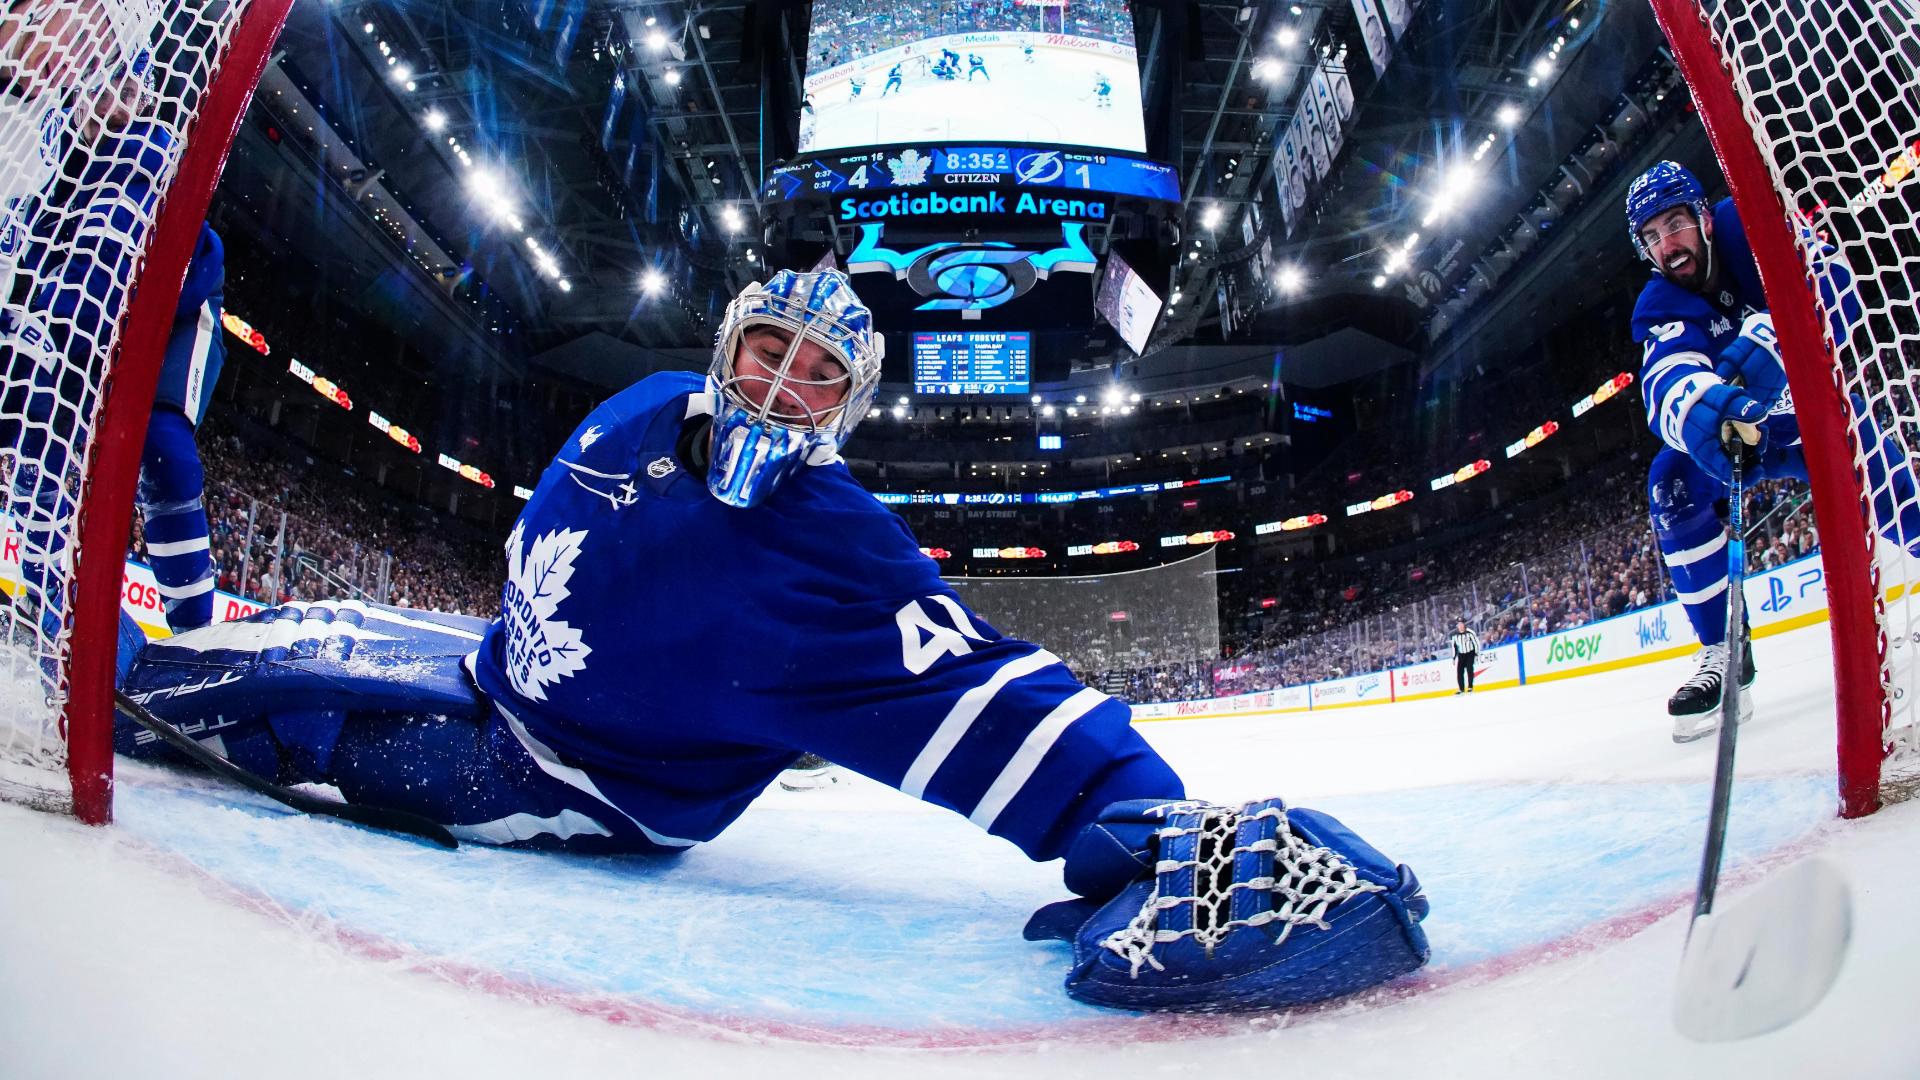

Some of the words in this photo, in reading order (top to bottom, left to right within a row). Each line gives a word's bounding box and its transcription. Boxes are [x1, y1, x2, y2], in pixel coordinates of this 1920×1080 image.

[965, 34, 1000, 43] Medals
[1046, 34, 1101, 49] Molson
[808, 66, 855, 88] Scotiabank
[946, 153, 995, 170] 8:35
[1094, 155, 1106, 164] 19
[773, 162, 813, 175] PENALTY
[814, 170, 832, 178] 0:37
[848, 165, 869, 189] 4
[1075, 165, 1091, 189] 1
[813, 181, 831, 189] 0:37
[944, 173, 1001, 183] CITIZEN
[840, 191, 1006, 220] Scotiabank
[1015, 193, 1105, 219] Arena
[1635, 192, 1657, 210] CCM
[1709, 315, 1733, 338] Milk
[507, 580, 551, 667] ORONTO
[1635, 609, 1672, 649] Milk
[896, 595, 994, 675] 41
[1547, 634, 1602, 665] Sobeys
[1411, 669, 1441, 686] rack.ca
[1176, 702, 1209, 716] Molson
